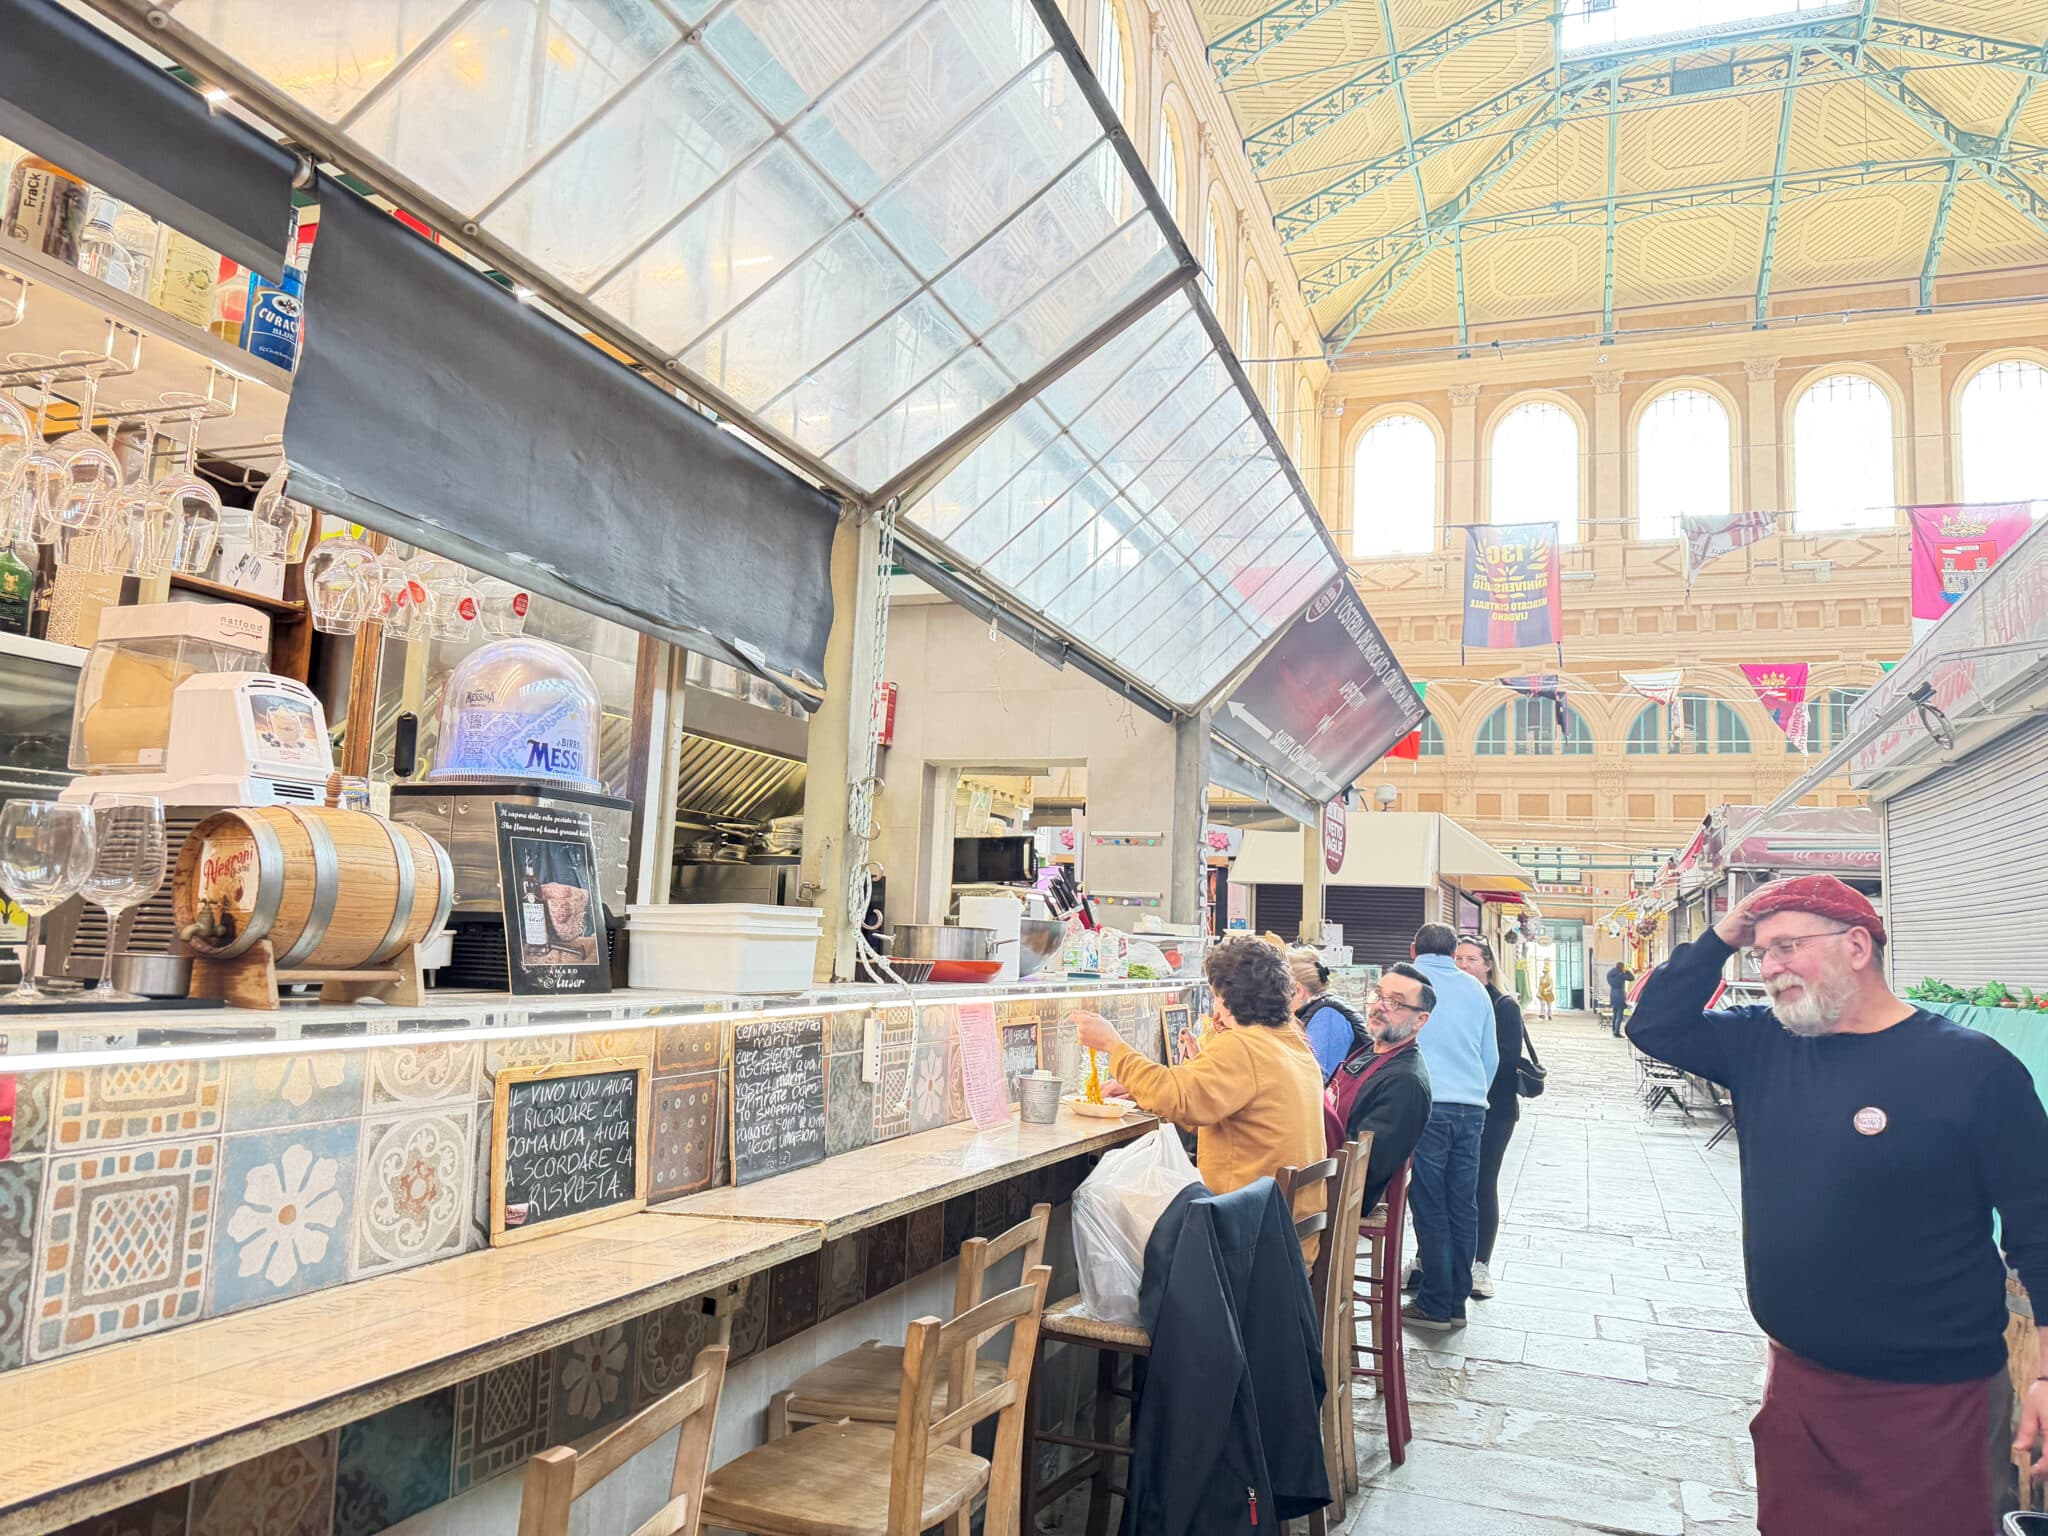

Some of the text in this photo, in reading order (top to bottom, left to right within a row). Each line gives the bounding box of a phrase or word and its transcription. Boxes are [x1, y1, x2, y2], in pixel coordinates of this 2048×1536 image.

[220, 616, 263, 631] natfood
[531, 1083, 565, 1104] VINO
[570, 1079, 601, 1099] NON
[601, 1077, 633, 1097] AIUTA
[524, 1101, 599, 1132] RICORDARE
[603, 1099, 623, 1118] LA
[593, 1120, 630, 1144] AIUTA
[505, 1146, 633, 1187] A SCORDARE LA
